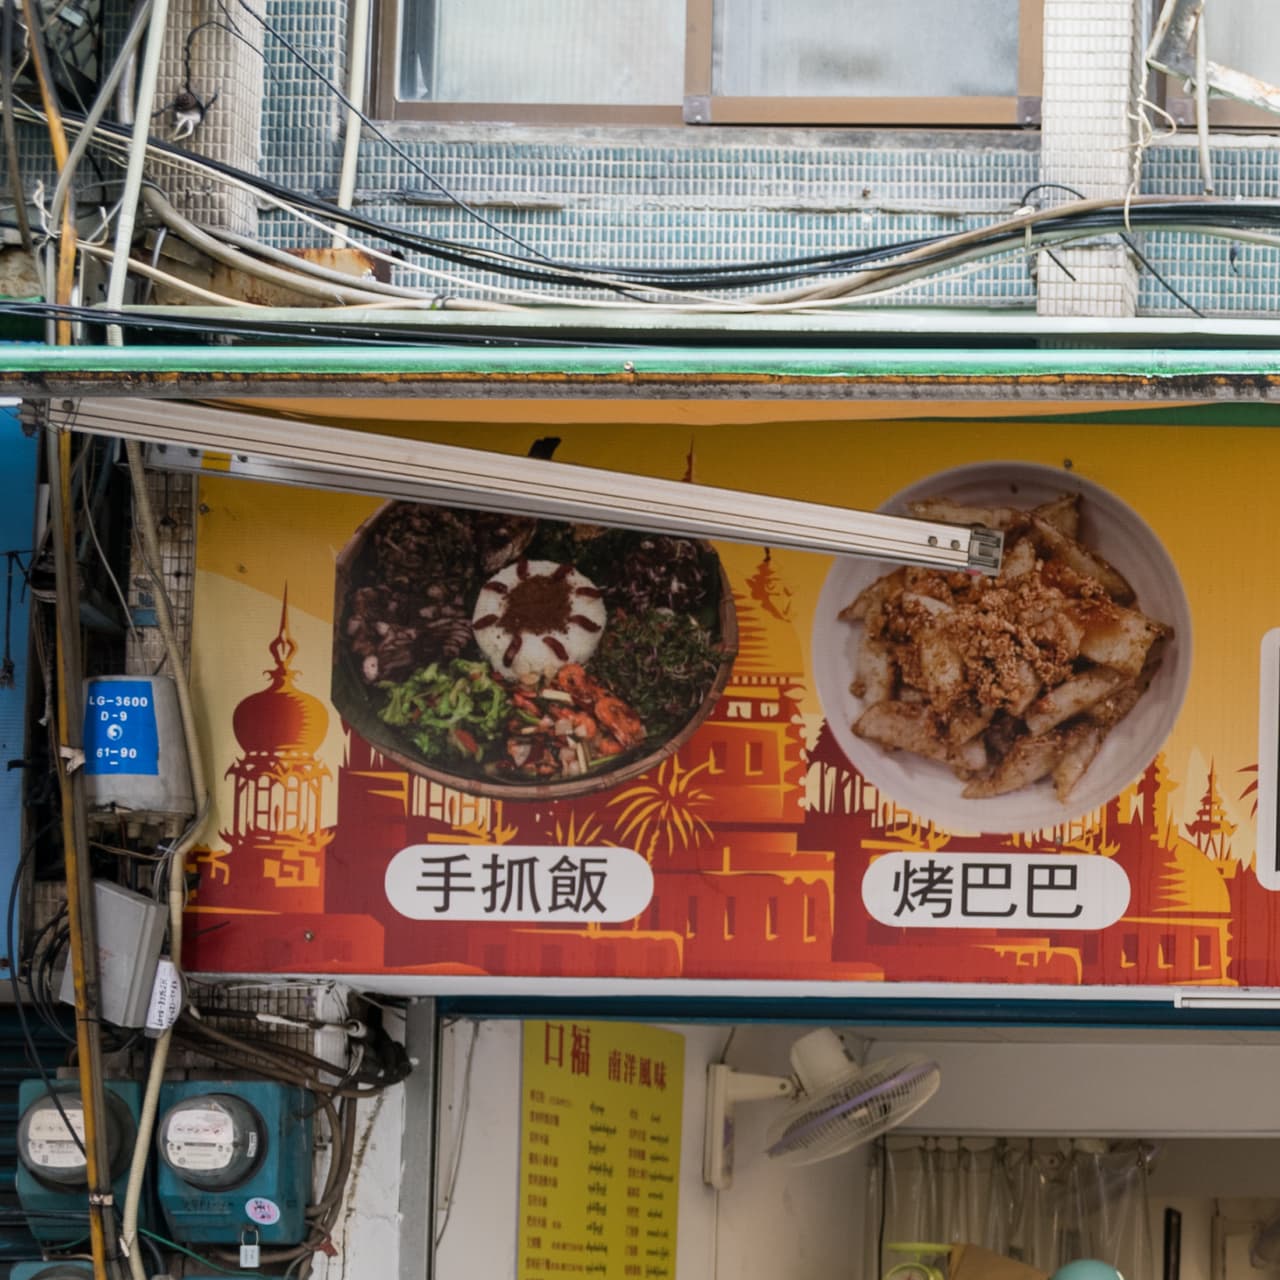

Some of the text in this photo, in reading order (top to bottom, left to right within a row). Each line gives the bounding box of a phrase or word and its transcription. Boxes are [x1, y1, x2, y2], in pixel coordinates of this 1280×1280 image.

[89, 695, 148, 707] LG-3600
[100, 711, 128, 721] D-9
[96, 747, 137, 759] 61-90
[415, 854, 609, 915] 手抓飯
[890, 859, 1085, 920] 烤巴巴
[544, 1022, 667, 1092] 口福 南洋風味
